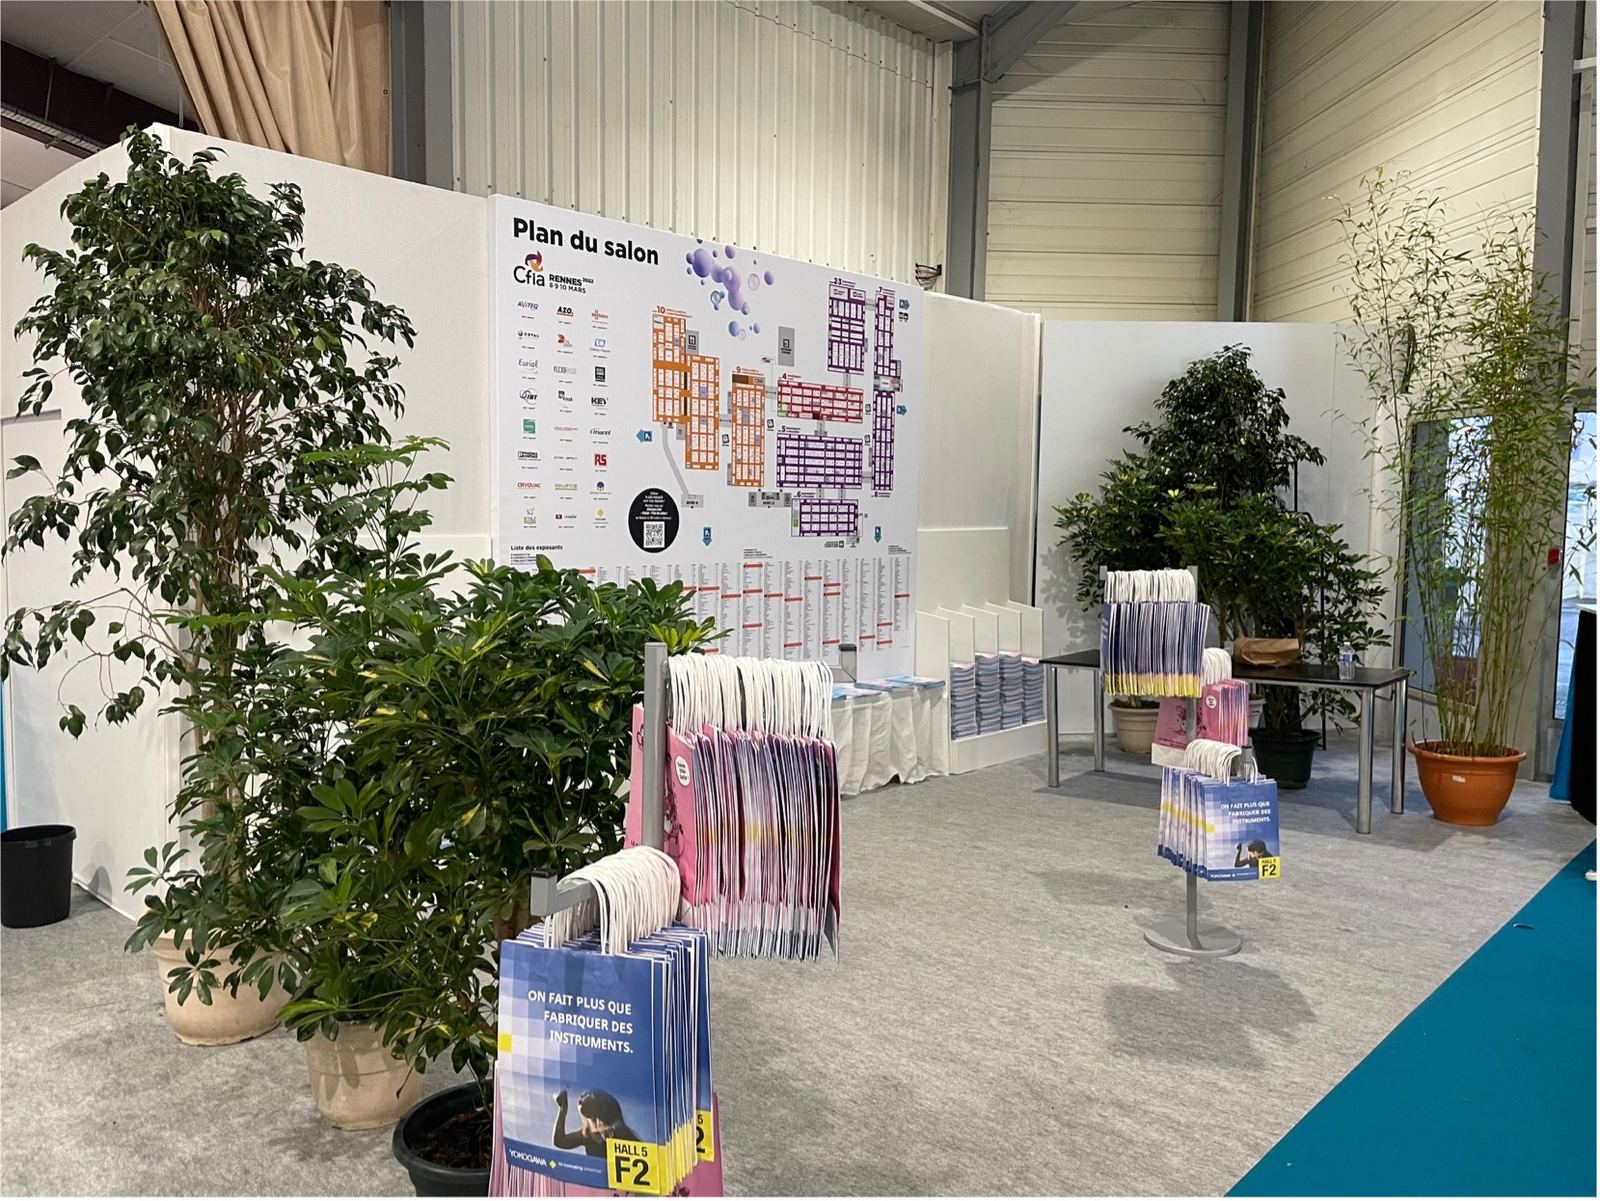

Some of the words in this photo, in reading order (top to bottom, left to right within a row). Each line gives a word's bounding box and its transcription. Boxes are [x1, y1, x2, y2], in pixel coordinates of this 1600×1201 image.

[513, 217, 563, 246] Plan
[570, 230, 598, 253] du
[604, 240, 659, 265] salon
[549, 273, 583, 286] RENNES
[568, 285, 586, 294] MARS
[656, 305, 666, 314] 10
[736, 366, 741, 374] 9
[782, 372, 787, 380] 4
[781, 425, 786, 433] 5
[594, 453, 607, 466] RS
[1262, 864, 1276, 877] F2
[528, 989, 546, 1003] ON
[549, 992, 573, 1007] FAIT
[576, 996, 605, 1011] PLUS
[607, 1000, 632, 1016] QUE
[544, 1011, 609, 1031] FABRIQUER
[611, 1020, 633, 1034] DES
[549, 1030, 634, 1054] INSTRUMENTS.
[614, 1142, 639, 1157] HALL
[641, 1144, 648, 1157] 5
[508, 1148, 547, 1167] YOKOGAWA
[614, 1155, 651, 1187] F2
